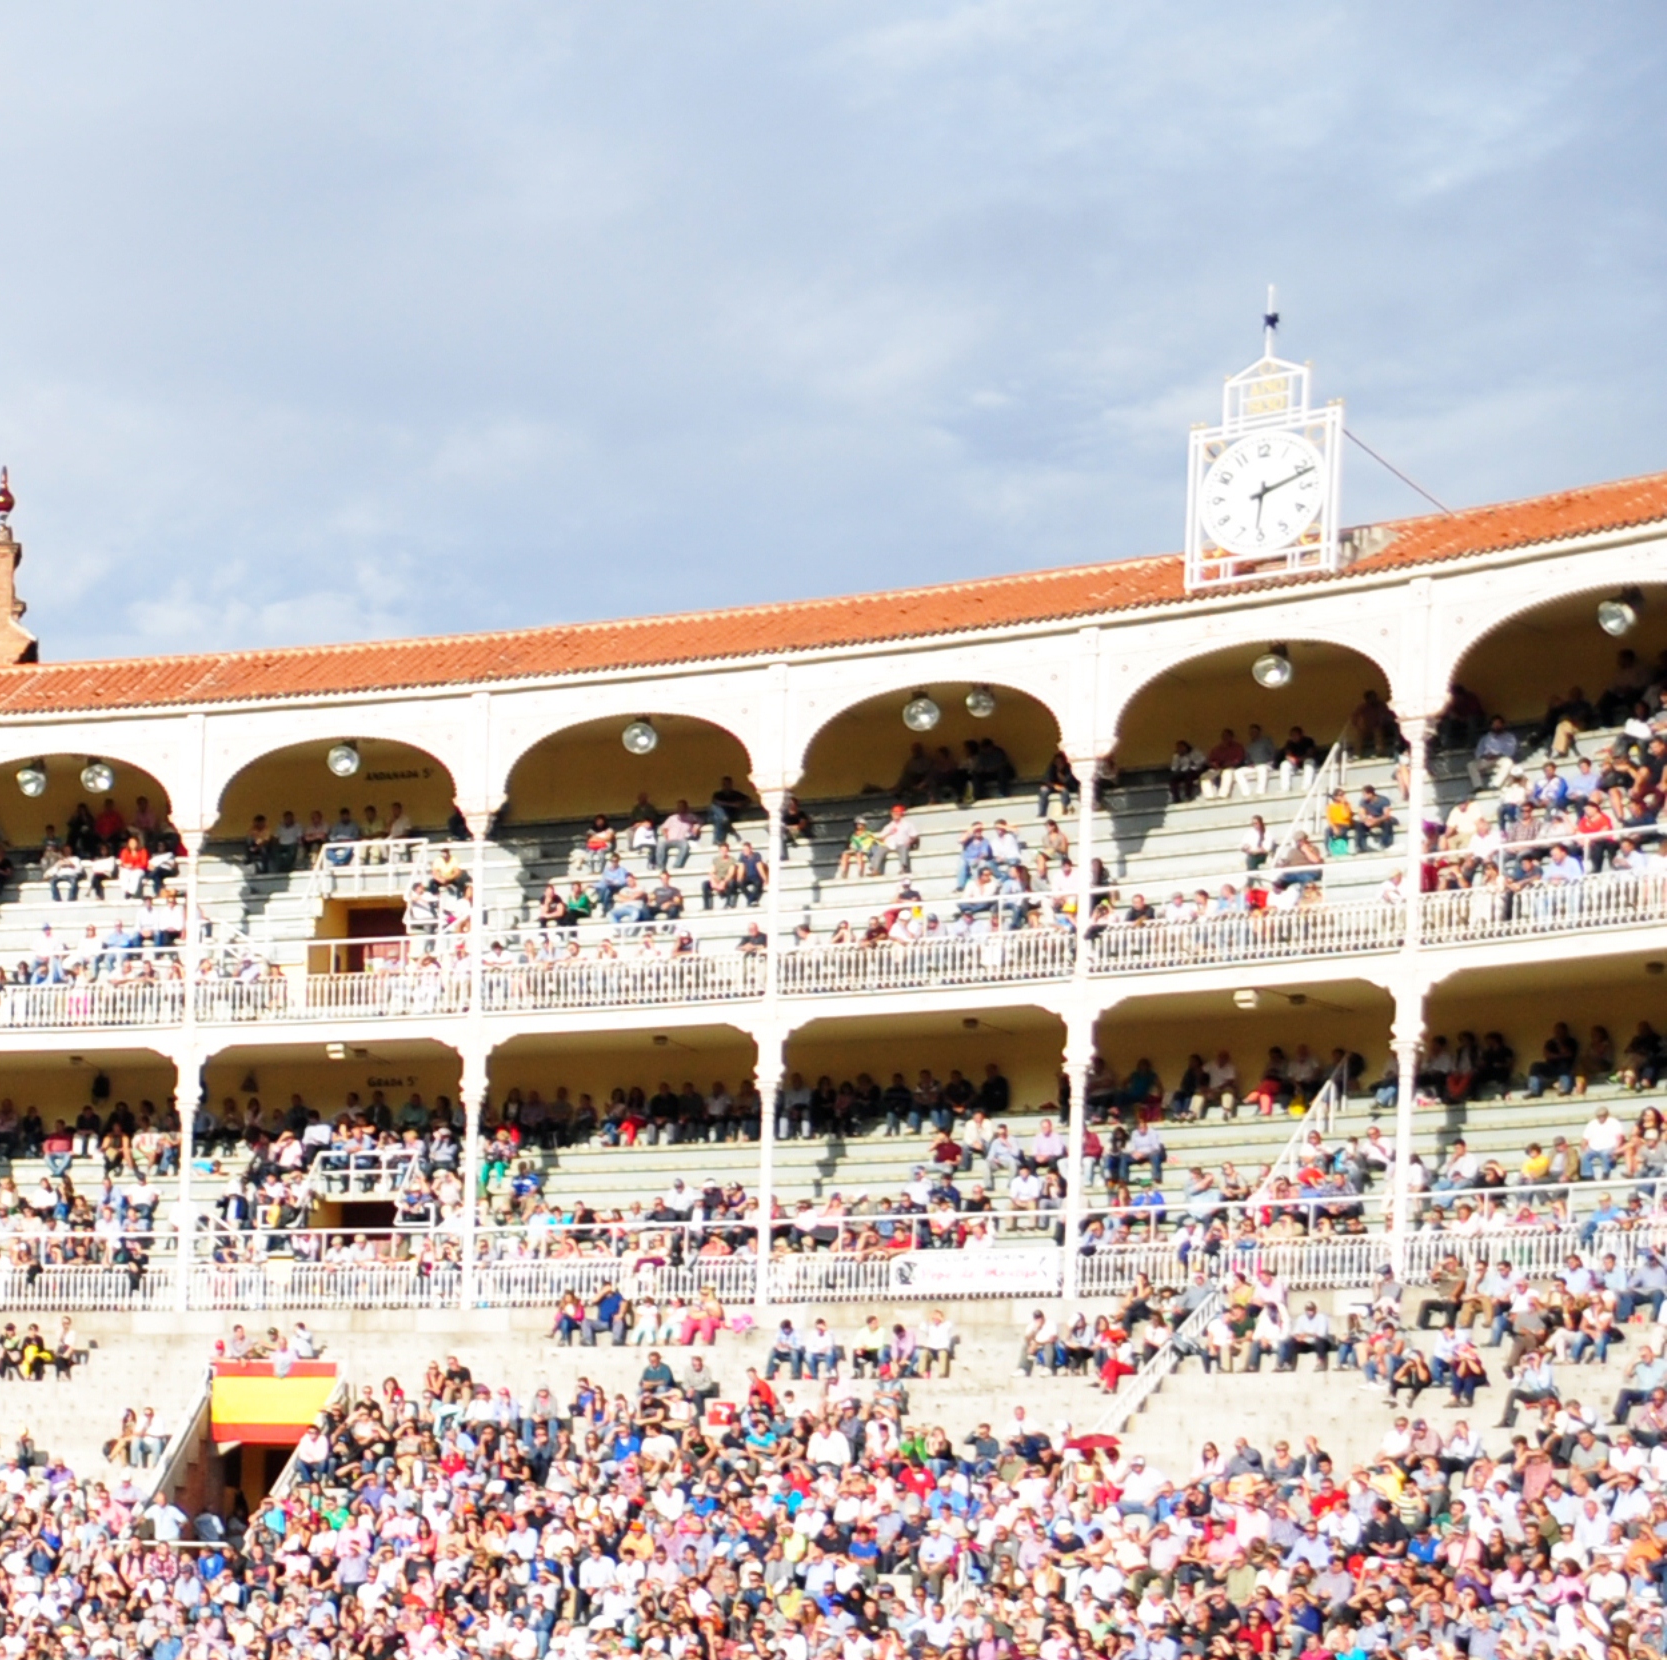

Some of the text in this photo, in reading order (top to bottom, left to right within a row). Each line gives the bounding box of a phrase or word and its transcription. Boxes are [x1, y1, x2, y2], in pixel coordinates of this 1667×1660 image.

[1257, 443, 1272, 458] 12
[1282, 446, 1289, 458] 1
[1235, 453, 1249, 468] 11
[1293, 459, 1308, 474] 2
[1219, 471, 1234, 486] 10
[1299, 481, 1313, 490] 3
[1212, 496, 1226, 506] 9
[1295, 502, 1306, 513] 4
[1217, 514, 1231, 526] 8
[1278, 519, 1289, 532] 5
[1235, 525, 1247, 538] 7
[1256, 527, 1265, 542] 6
